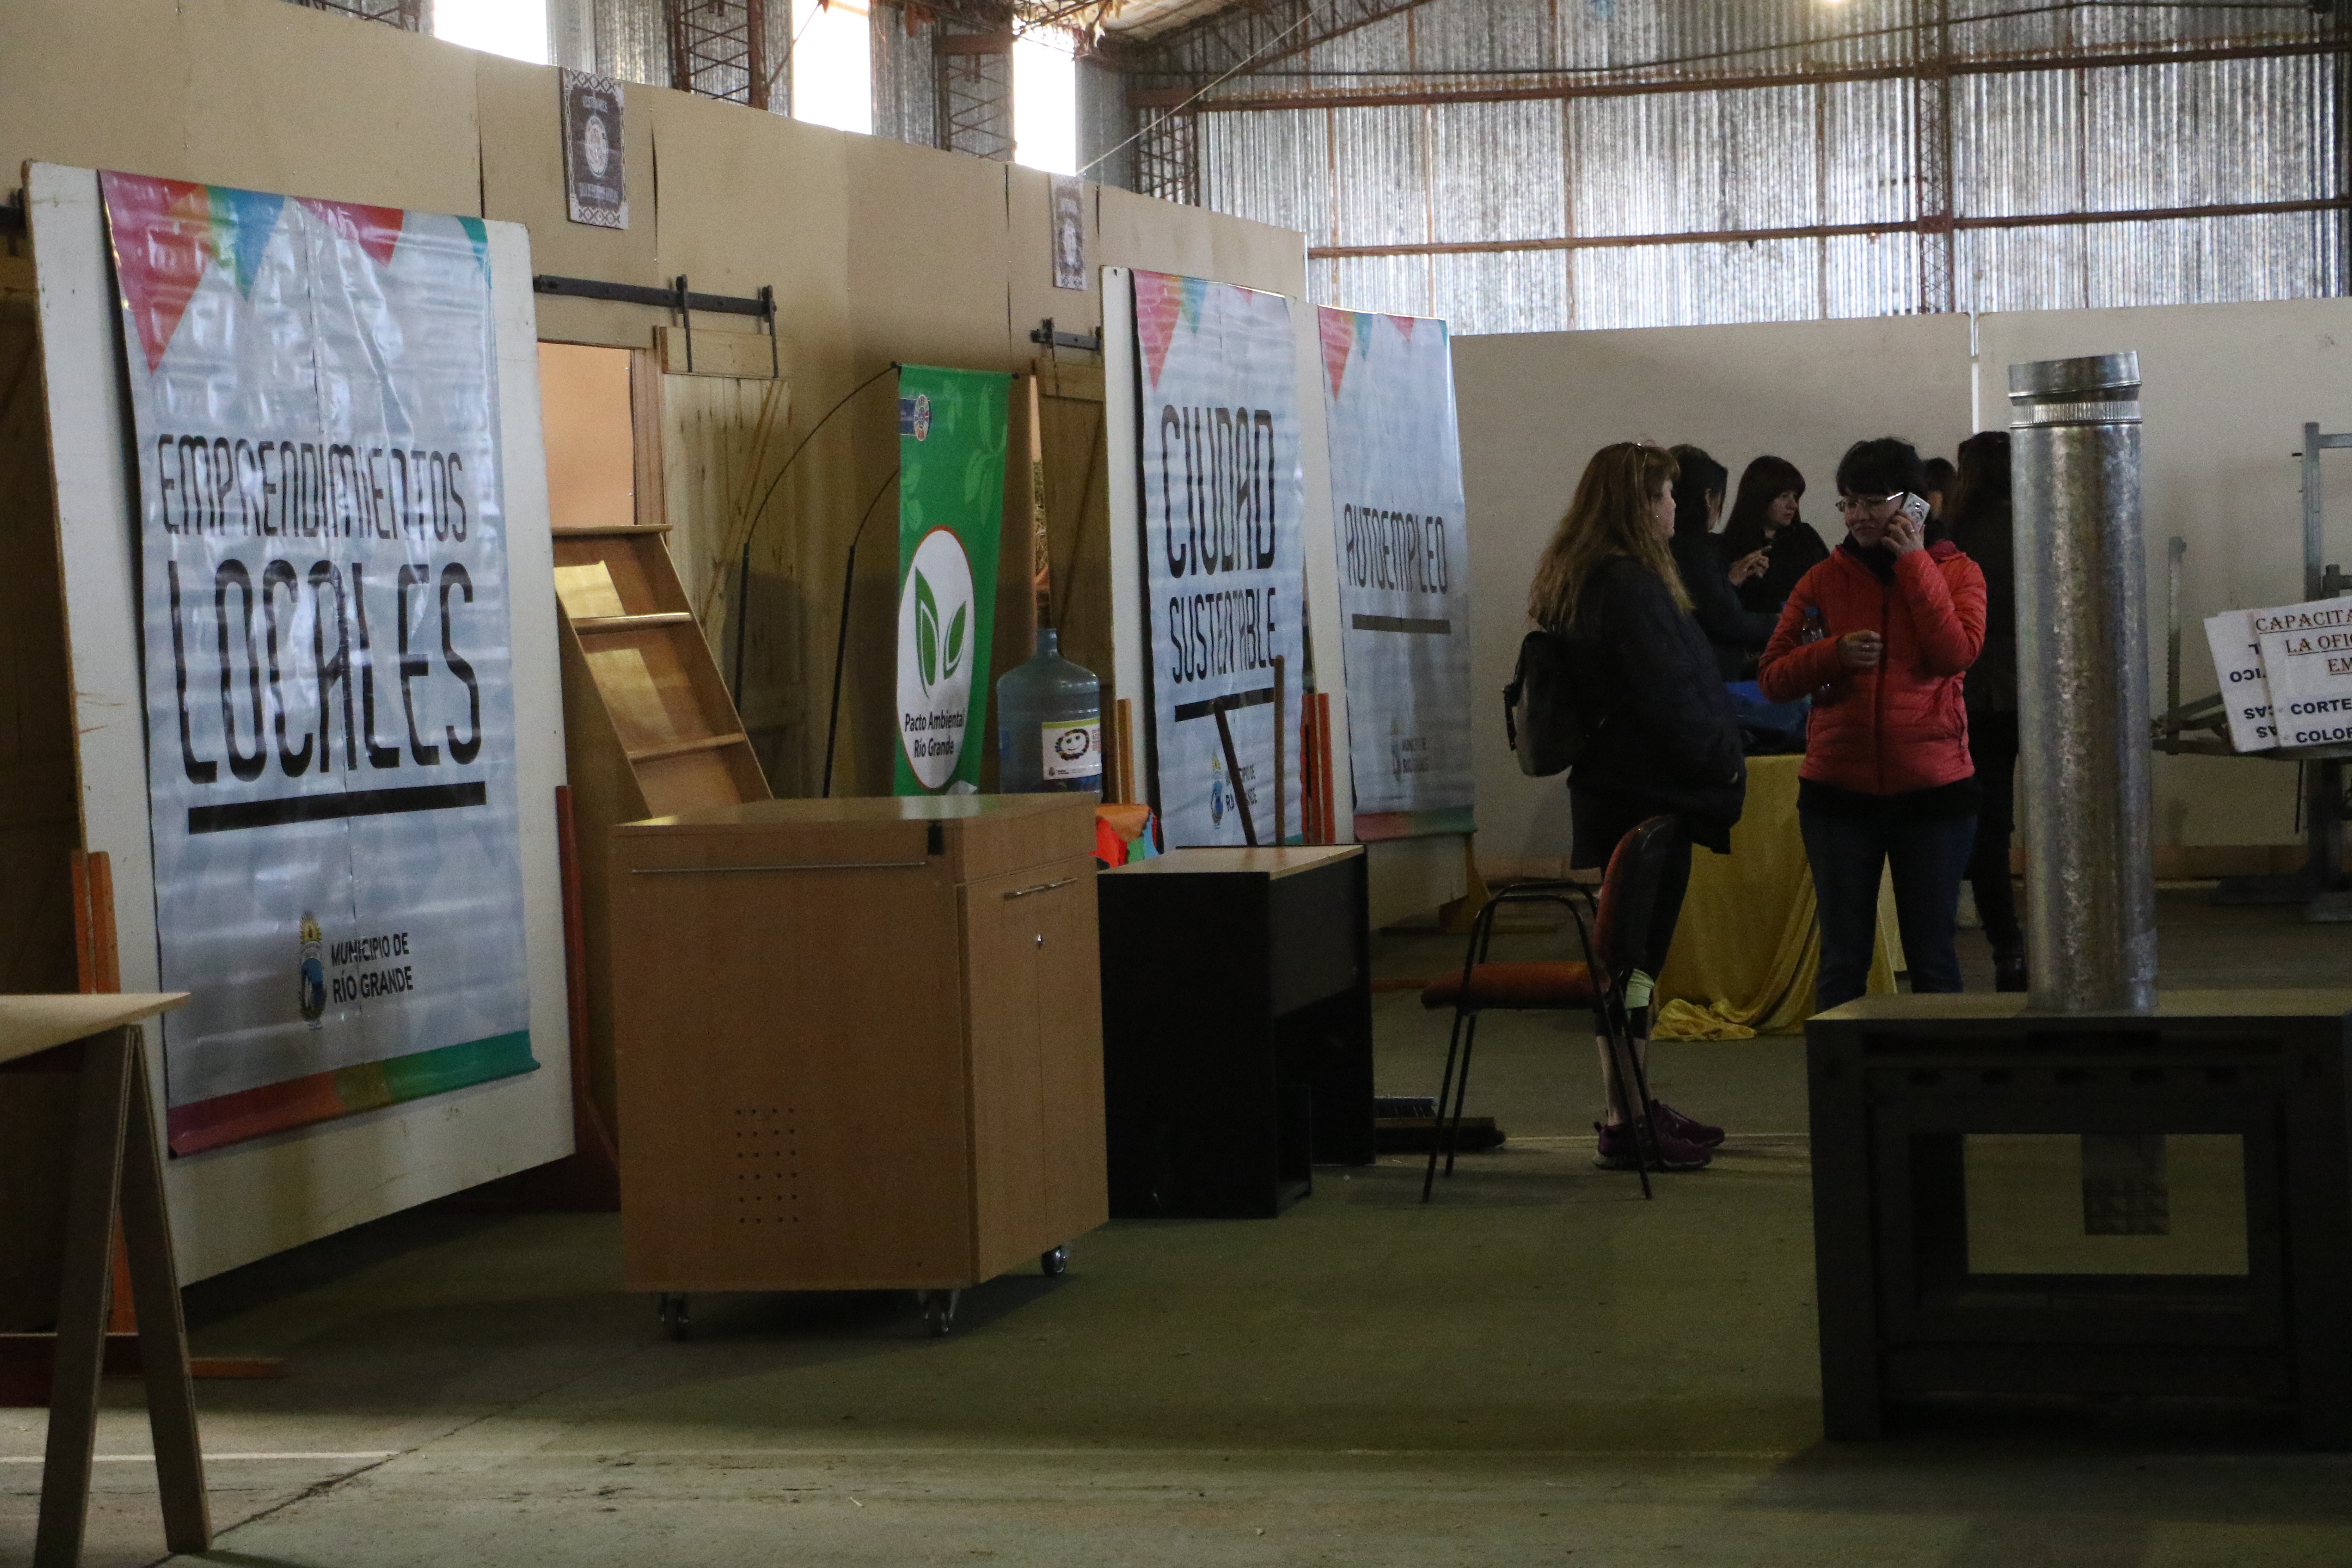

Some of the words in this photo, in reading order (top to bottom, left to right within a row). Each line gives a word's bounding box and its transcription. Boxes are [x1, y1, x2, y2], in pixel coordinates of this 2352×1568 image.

[158, 433, 468, 543] EMPRENDIMIENTOS
[1161, 404, 1275, 579] CIUDAD
[1344, 502, 1448, 595] AUTOEMPLEO
[1170, 588, 1275, 684] SUSTENTABLE
[2285, 638, 2312, 653] LA
[2318, 634, 2352, 649] OFI
[167, 559, 482, 784] LOCALES
[905, 713, 926, 732] Pacto
[928, 707, 965, 730] Ambiental
[2291, 698, 2352, 715] CORTE
[914, 738, 926, 758] Río
[928, 735, 954, 756] Grande
[331, 935, 390, 967] MUNICIPIO
[393, 932, 410, 956] DE
[333, 969, 357, 1004] RÍO
[360, 965, 414, 999] GRANDE
